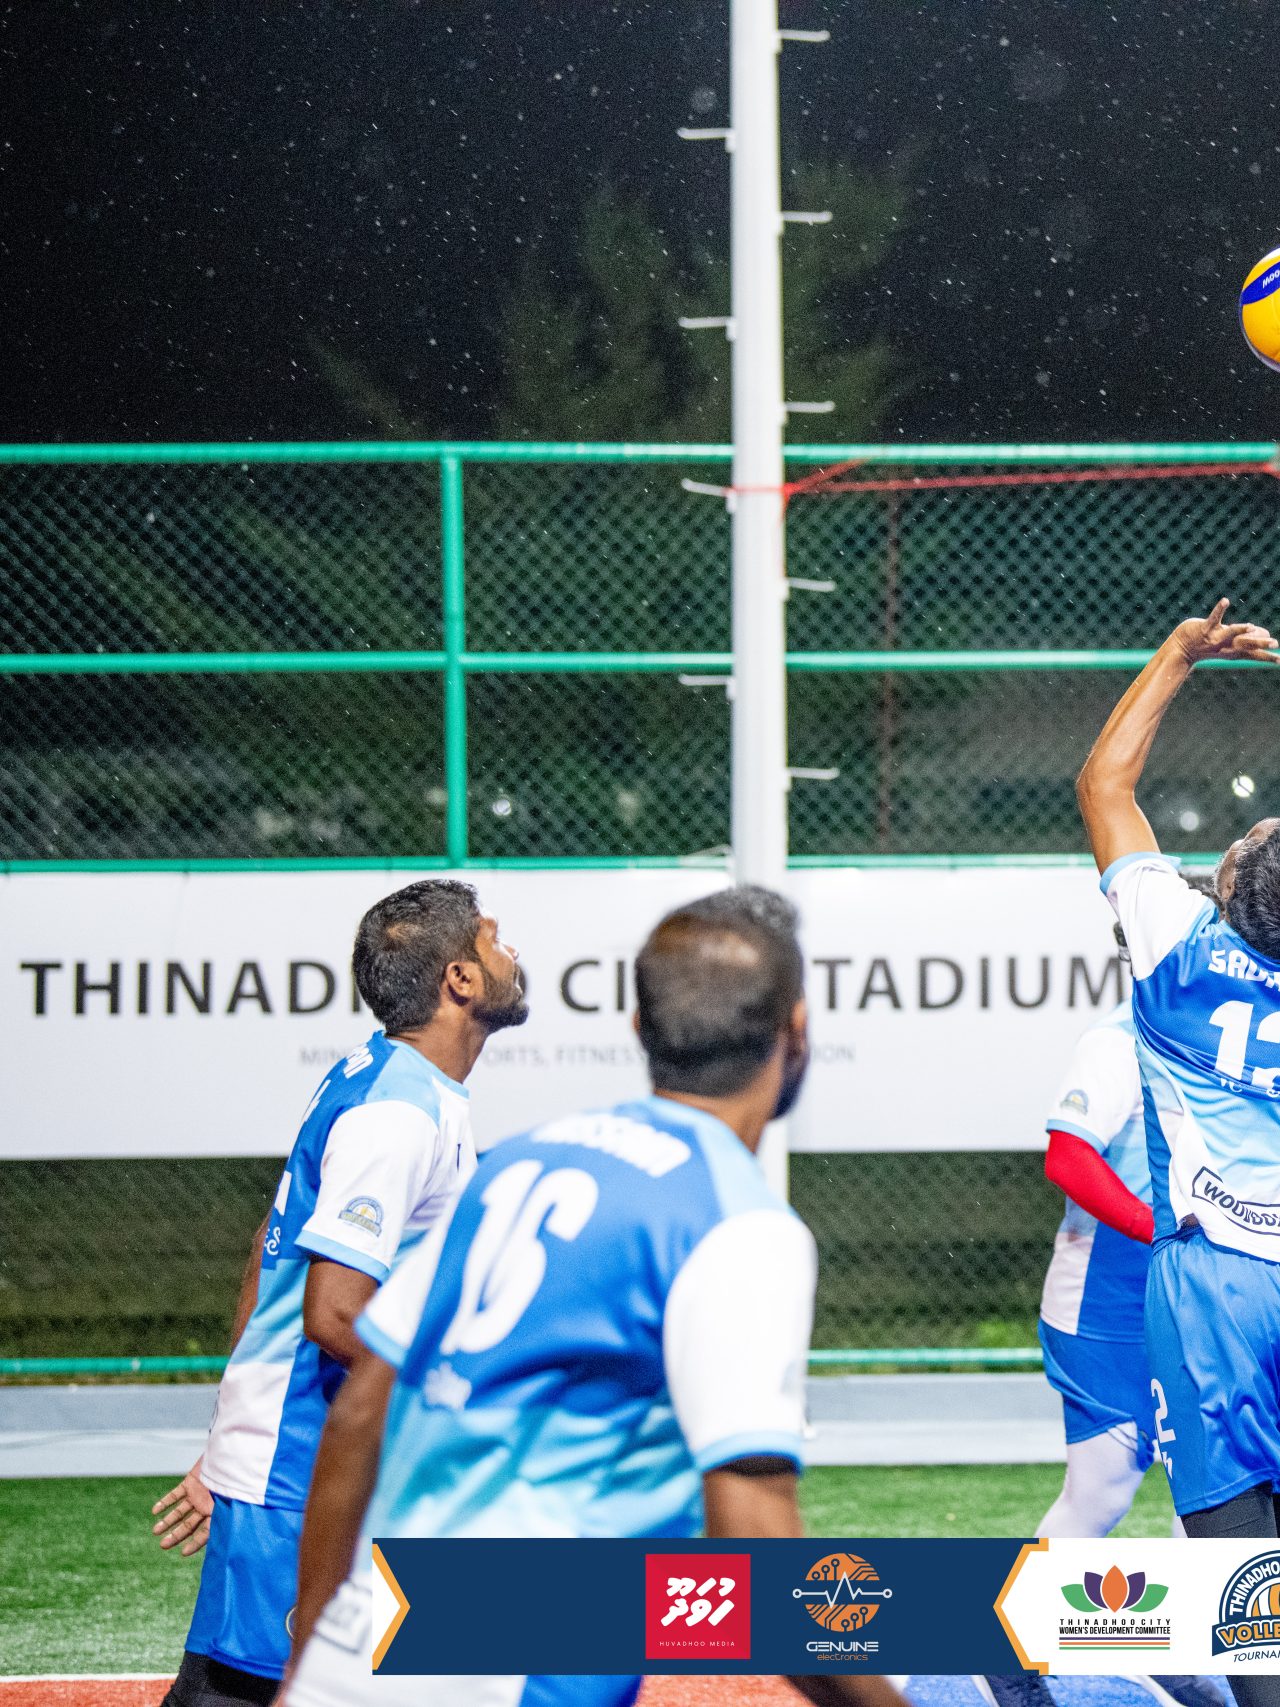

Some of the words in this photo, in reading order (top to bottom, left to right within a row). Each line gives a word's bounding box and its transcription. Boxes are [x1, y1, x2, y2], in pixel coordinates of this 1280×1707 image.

[20, 959, 527, 1016] THINAD
[560, 959, 626, 1012] CI
[811, 956, 1126, 1010] TADIUM
[441, 1158, 599, 1354] 16
